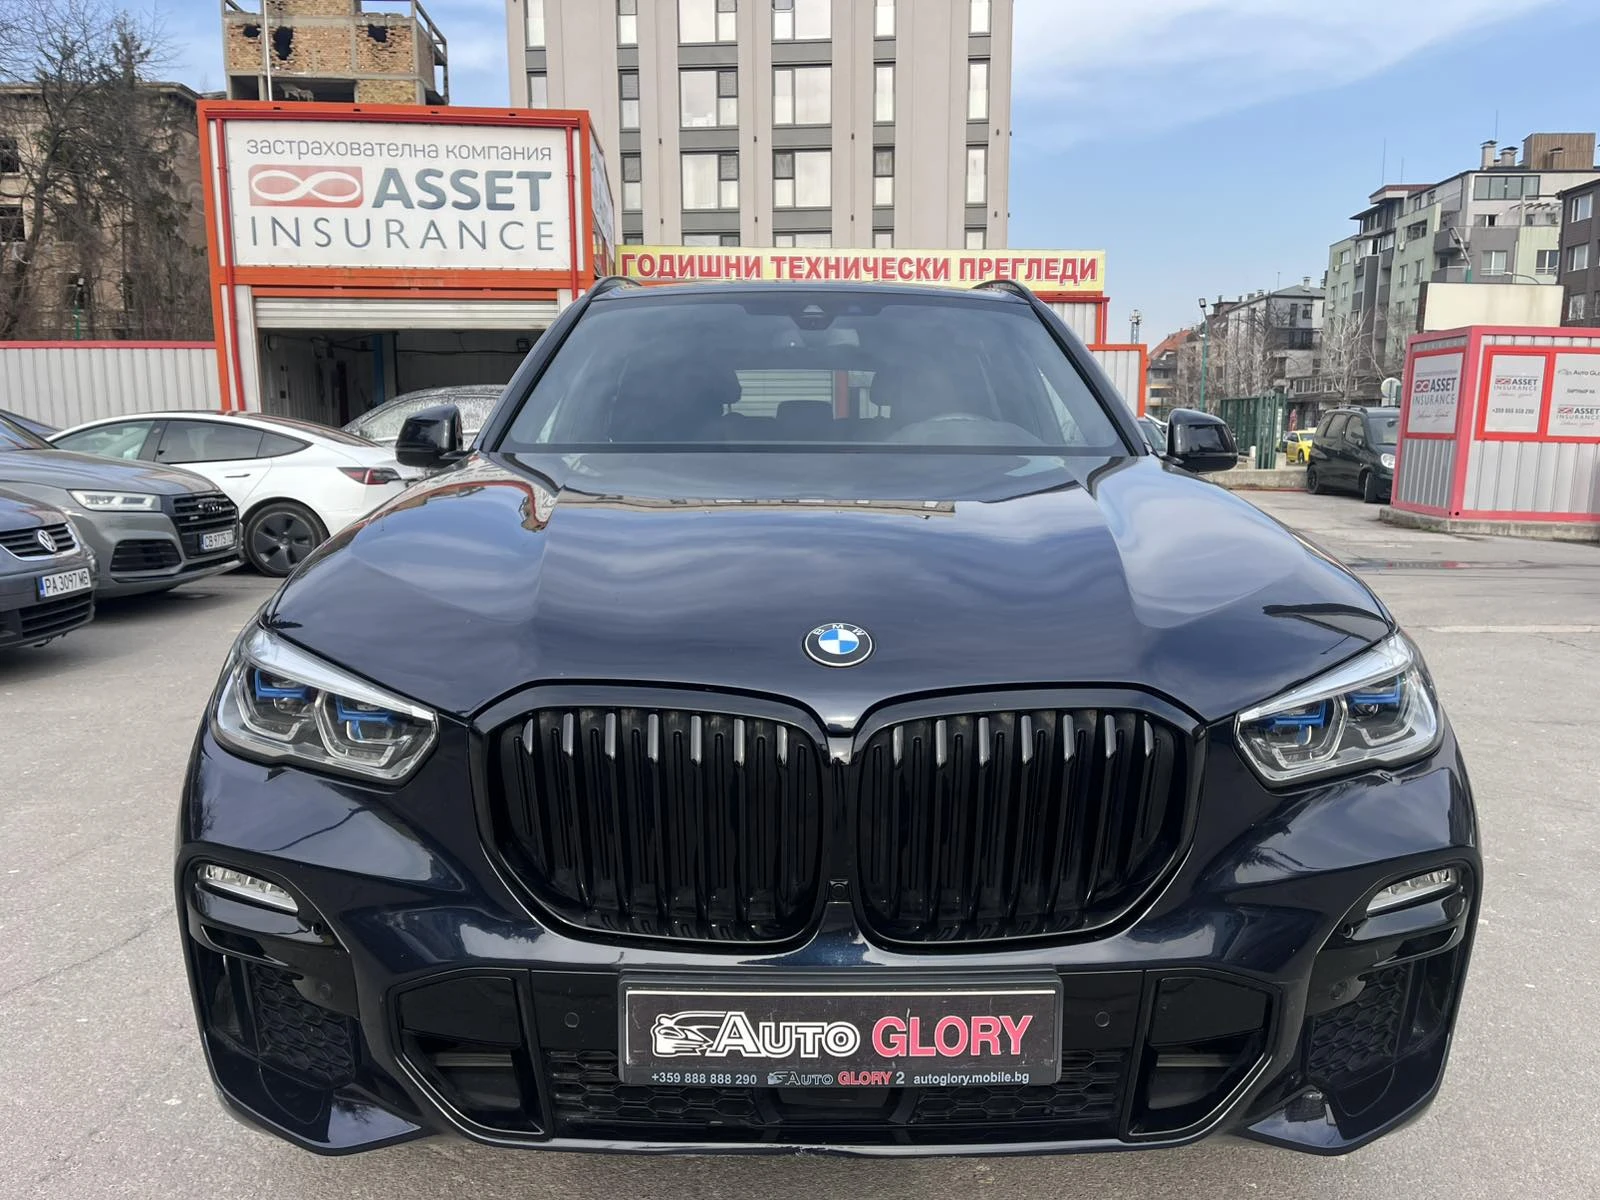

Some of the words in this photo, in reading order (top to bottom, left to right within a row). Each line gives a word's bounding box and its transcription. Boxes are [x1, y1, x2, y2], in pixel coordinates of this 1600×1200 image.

[246, 138, 438, 160] застрахователна
[446, 144, 552, 161] компания
[371, 167, 552, 211] ASSET
[251, 215, 554, 251] INSURANCE
[621, 253, 762, 279] ГОДИШНИ
[770, 256, 949, 281] ТЕХНИЧЕСКИ
[959, 257, 1098, 284] ПРЕГЛЕДИ
[1430, 377, 1457, 392] ASSET
[1512, 378, 1538, 386] ASSET
[1574, 407, 1600, 415] ASSET
[812, 624, 865, 636] BMW
[871, 1015, 1034, 1058] GLORY
[651, 1072, 681, 1083] +359
[684, 1072, 706, 1084] 888
[710, 1073, 732, 1084] 888
[735, 1074, 757, 1085] 290
[838, 1071, 892, 1085] GLORY
[895, 1072, 905, 1085] 2
[913, 1072, 1030, 1086] autoglory.mobile.bg
